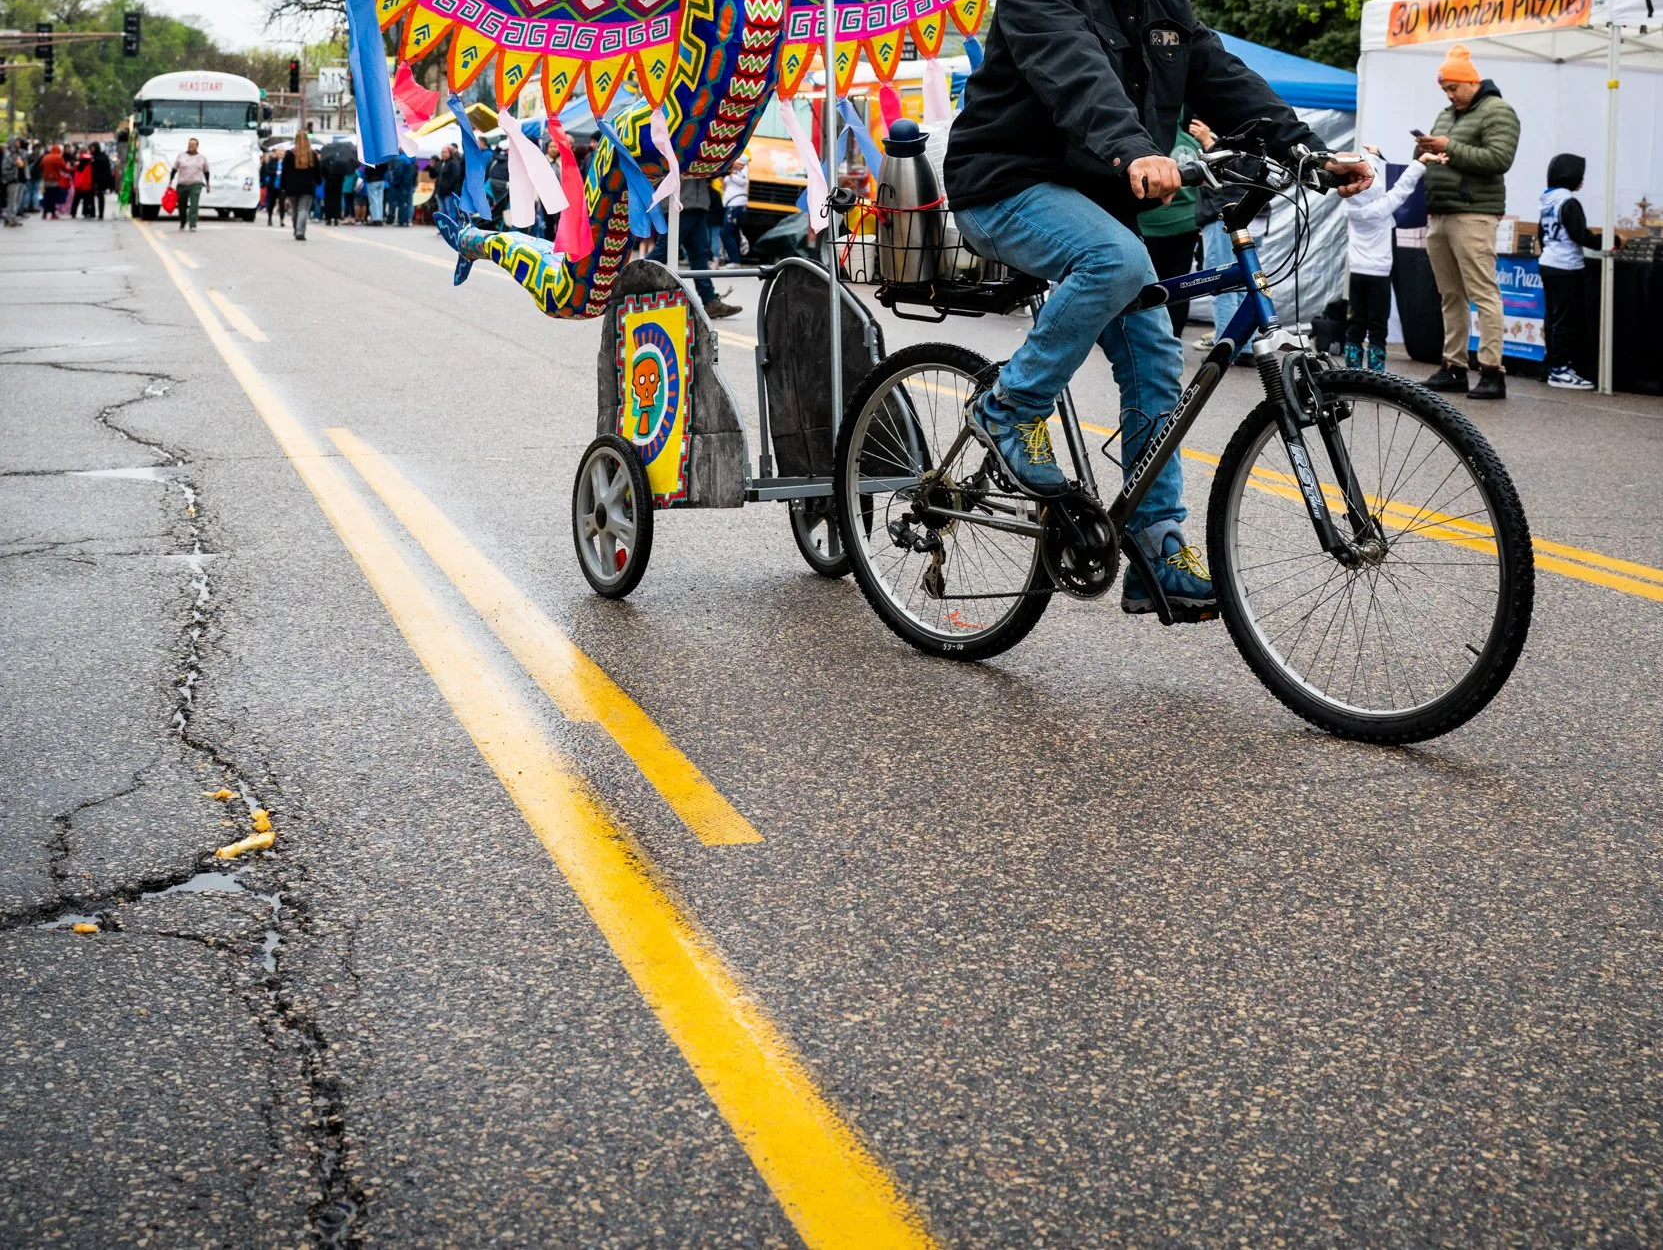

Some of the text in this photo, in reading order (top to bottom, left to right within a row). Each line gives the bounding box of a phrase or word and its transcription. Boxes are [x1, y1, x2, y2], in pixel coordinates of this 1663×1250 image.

[179, 81, 223, 92] HEAD START
[1513, 266, 1544, 288] Puzz
[1287, 441, 1325, 507] RST
